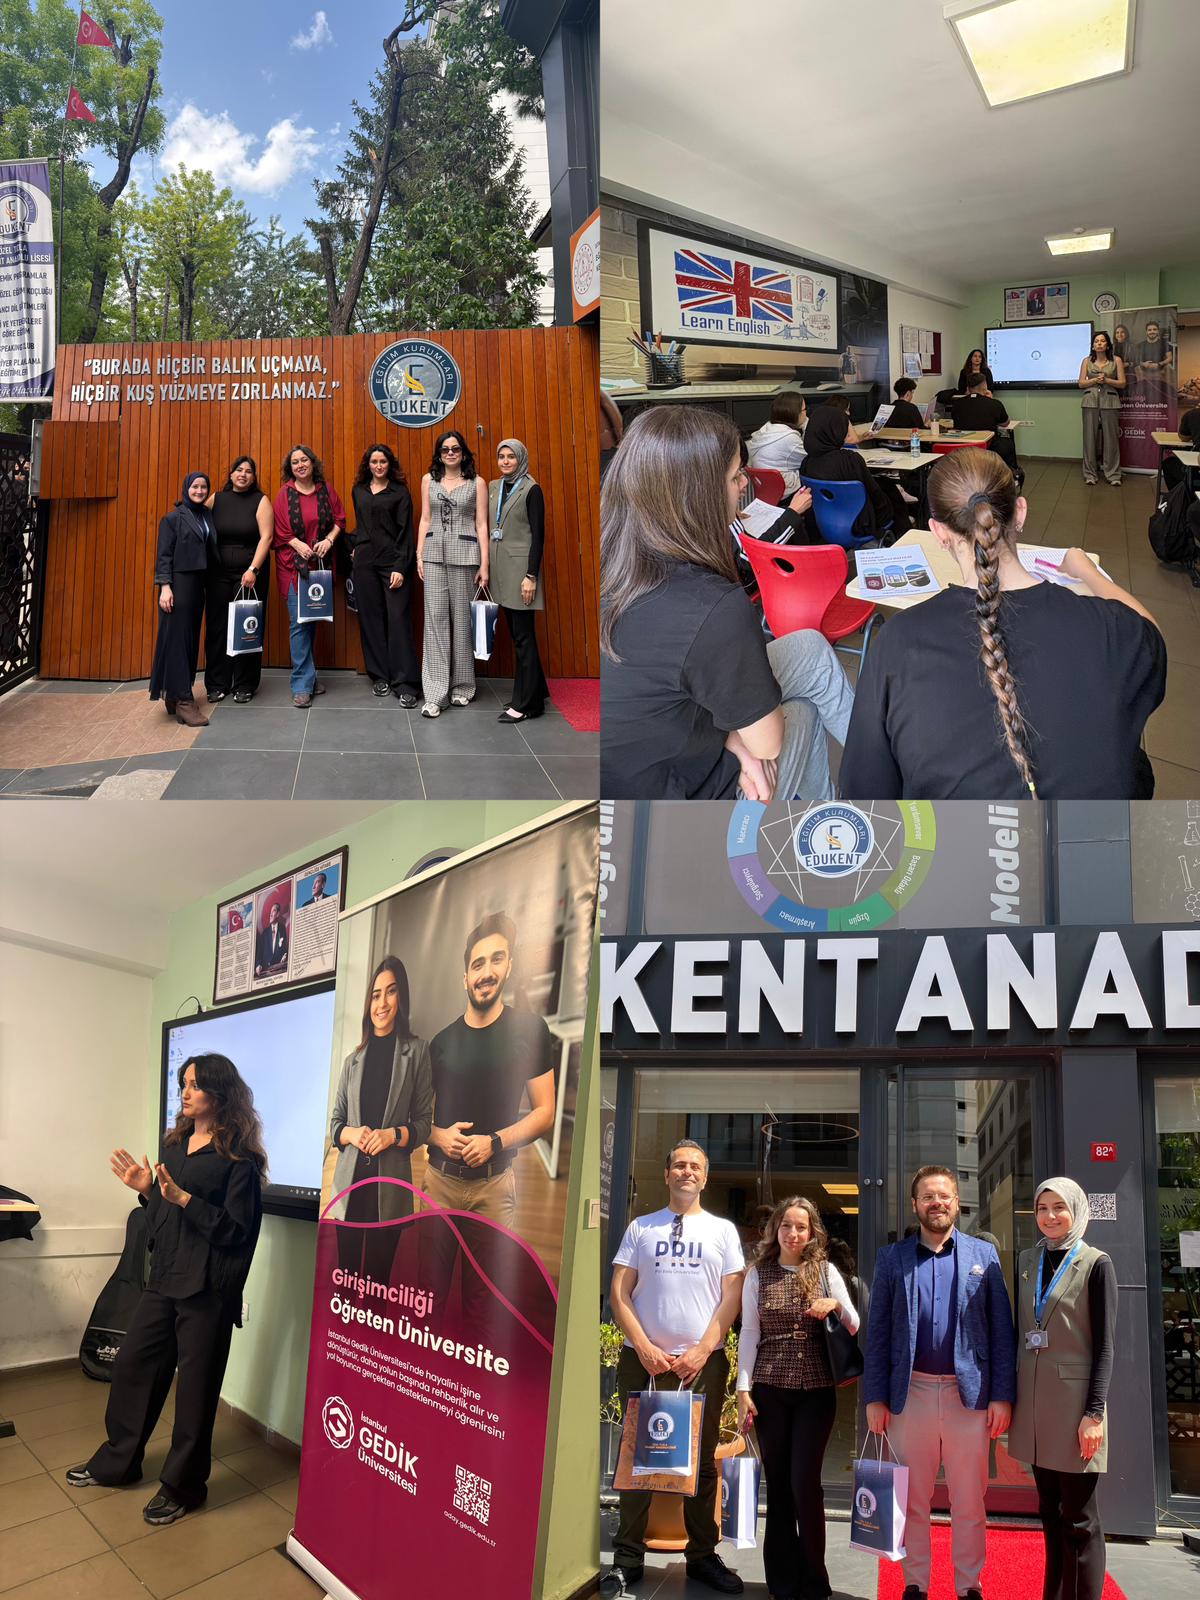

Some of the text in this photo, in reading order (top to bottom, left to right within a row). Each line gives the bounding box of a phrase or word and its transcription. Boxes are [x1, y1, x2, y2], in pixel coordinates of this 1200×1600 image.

[31, 253, 51, 262] LİSESİ
[681, 312, 771, 336] Learn English
[157, 353, 206, 378] HİÇBİR
[212, 356, 256, 375] BALIK
[261, 354, 328, 378] UÇMAYA,
[403, 345, 454, 384] KURUMLARI
[71, 380, 119, 405] HİÇBİR
[127, 384, 155, 406] KUŞ
[160, 380, 226, 401] YÜZMEYE
[380, 400, 449, 415] EDUKENT
[824, 809, 867, 840] KURUMLARI
[805, 853, 862, 867] EDUKENT
[988, 804, 1020, 924] Modeli
[779, 910, 816, 930] Araştırmacı
[848, 912, 870, 926] Özgün
[600, 937, 879, 1034] KENT
[1095, 1146, 1114, 1157] 82A
[331, 1268, 434, 1318] Girişimciliği
[329, 1292, 510, 1376] Öğreten Üniversite
[327, 1328, 481, 1400] İstanbul Gedik Üniversitesi'nde hayalini işine
[326, 1352, 505, 1440] yol boyunca gerçekten desteklenmeyi öğrenirsin!
[327, 1340, 499, 1423] dönüştürür, daha yolun başında rehberlik alır ve
[360, 1411, 388, 1434] İstanbul
[359, 1426, 419, 1479] GEDİK
[357, 1448, 417, 1496] Üniversitesi
[443, 1510, 497, 1547] aday.gedik.edu.tr
